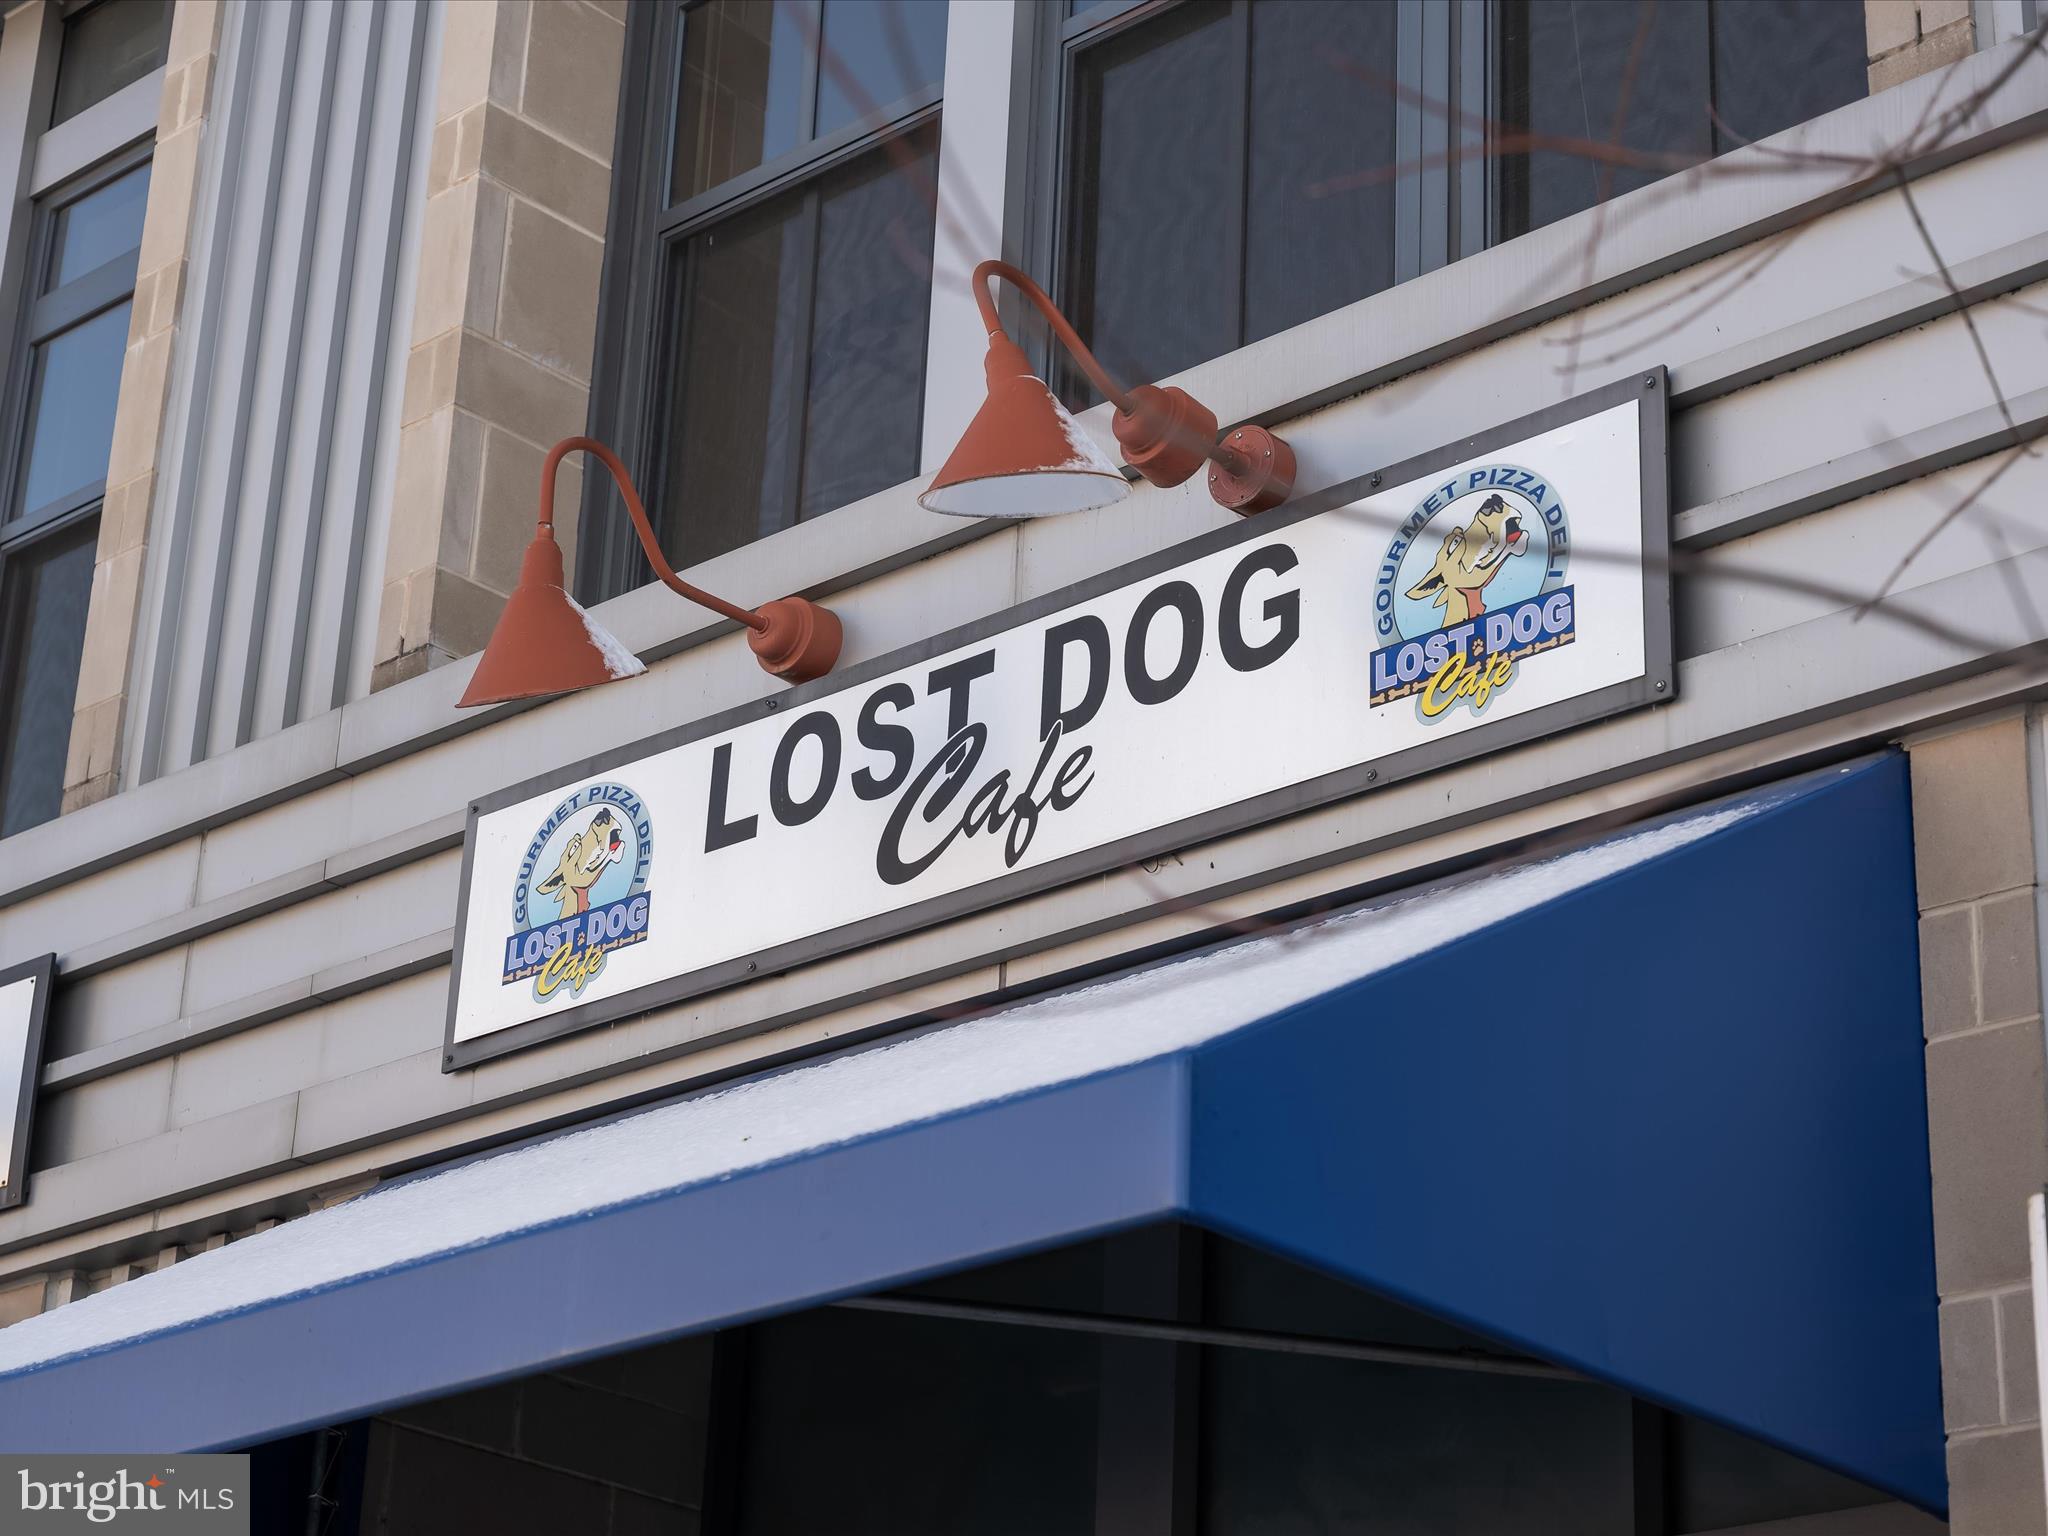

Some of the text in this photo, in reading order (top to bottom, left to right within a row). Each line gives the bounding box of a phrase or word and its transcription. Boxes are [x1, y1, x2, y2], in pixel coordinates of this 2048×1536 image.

[1377, 468, 1567, 635] GOURMET PIZZA DELI
[704, 542, 1300, 854] LOST DOG
[1375, 593, 1571, 691] LOST DOG
[1421, 652, 1513, 717] Cafe
[515, 785, 650, 923] GOURMET PIZZA DELI
[876, 719, 1095, 885] Cafe
[507, 896, 648, 971] LOST DOG
[537, 943, 603, 996] Cafe
